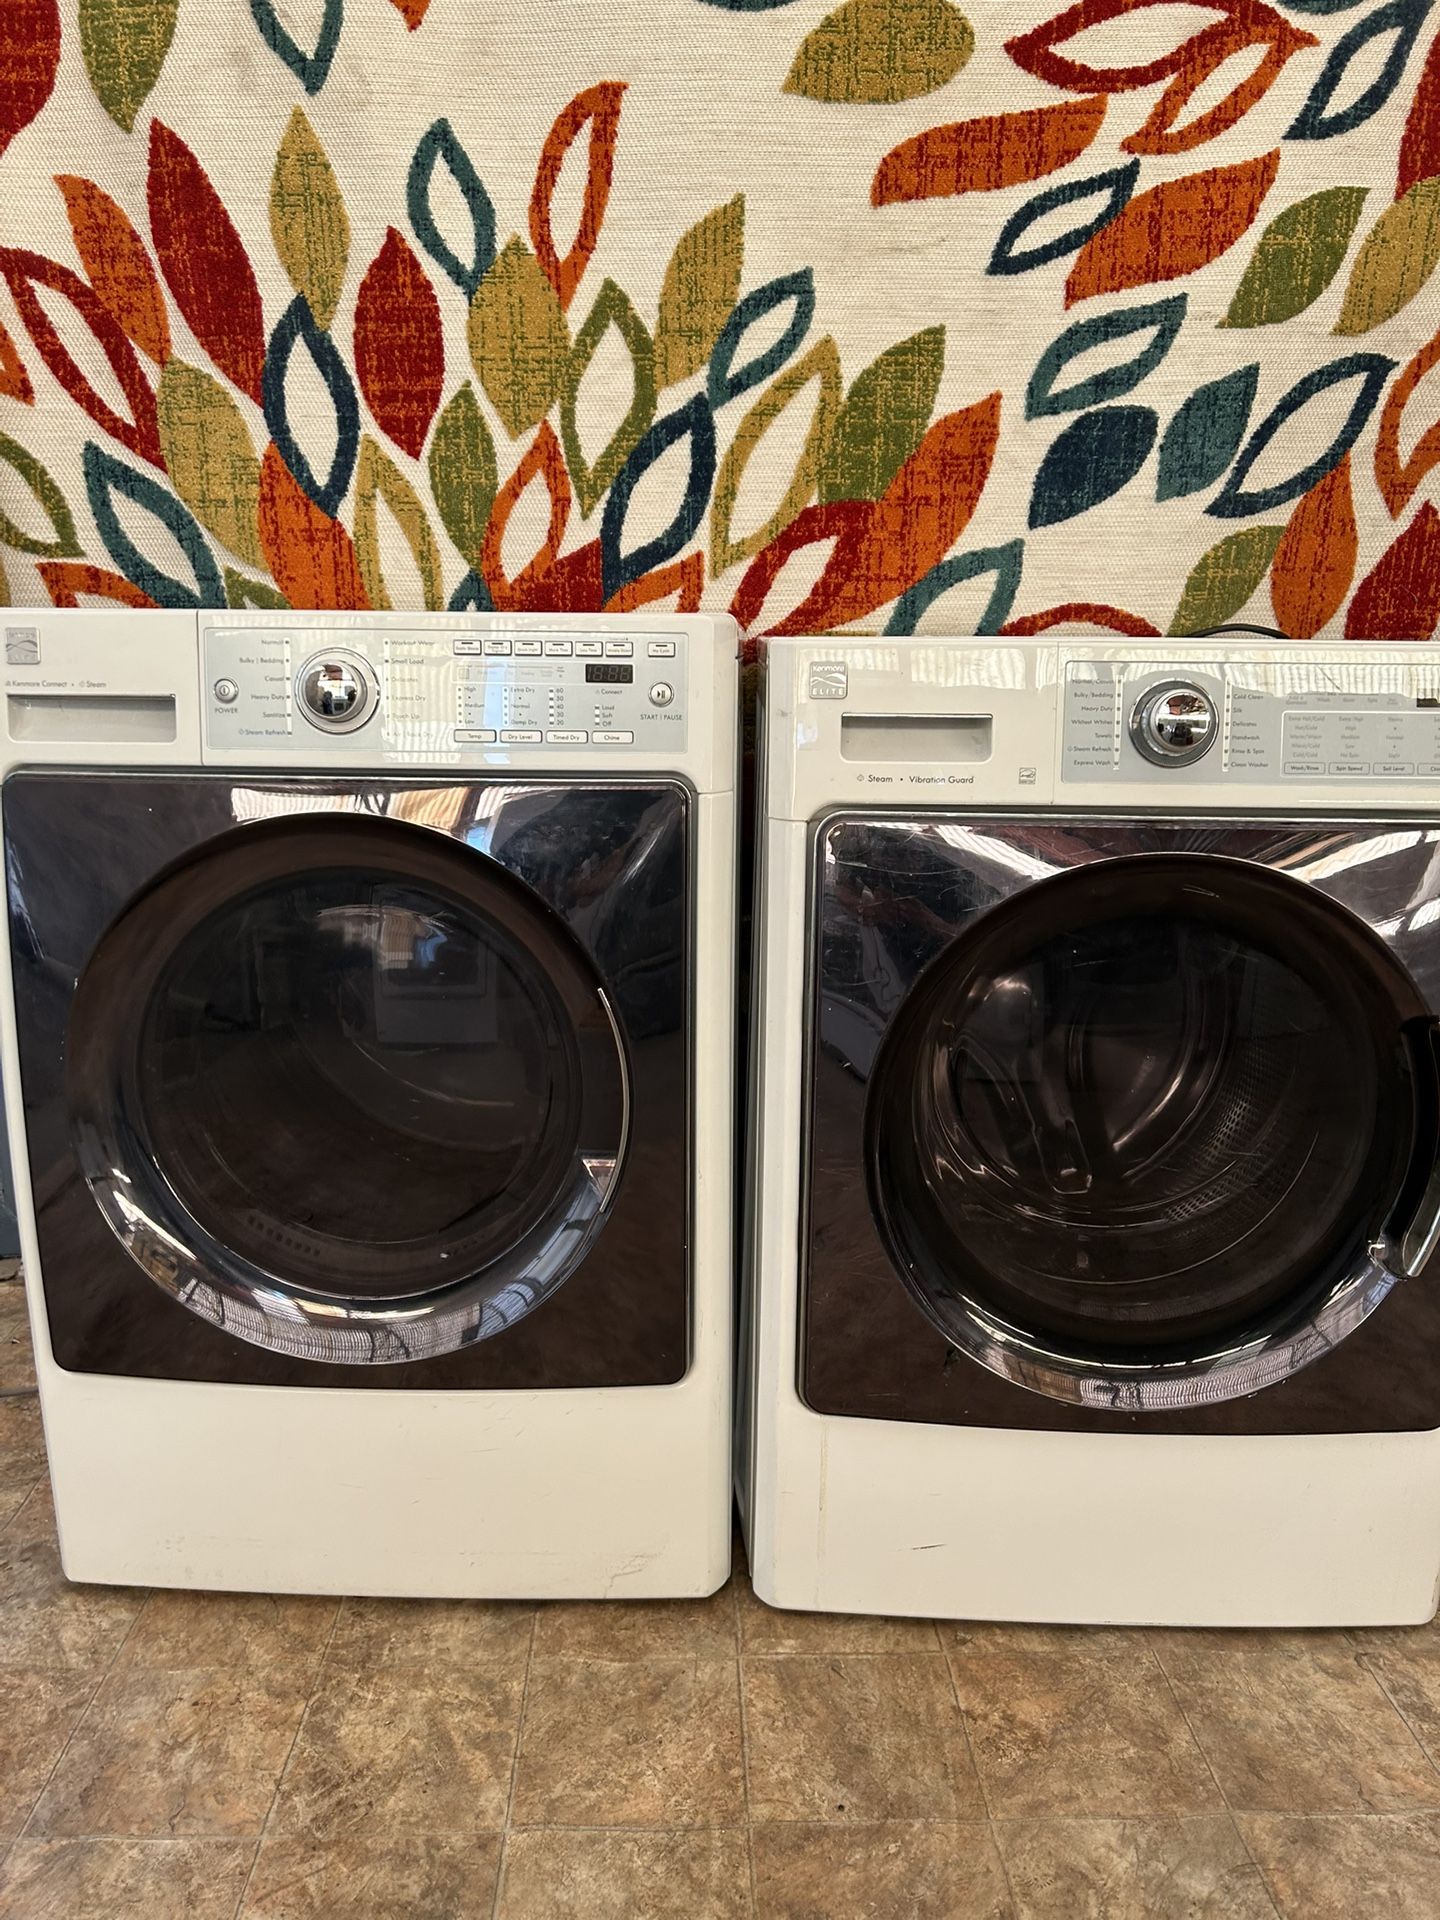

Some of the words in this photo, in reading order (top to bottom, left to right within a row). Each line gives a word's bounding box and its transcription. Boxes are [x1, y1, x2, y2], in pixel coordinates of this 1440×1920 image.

[41, 680, 67, 688] Connect
[812, 687, 844, 696] ELITE
[868, 774, 893, 783] Steam
[909, 775, 946, 784] Vibration
[947, 775, 975, 784] Guard
